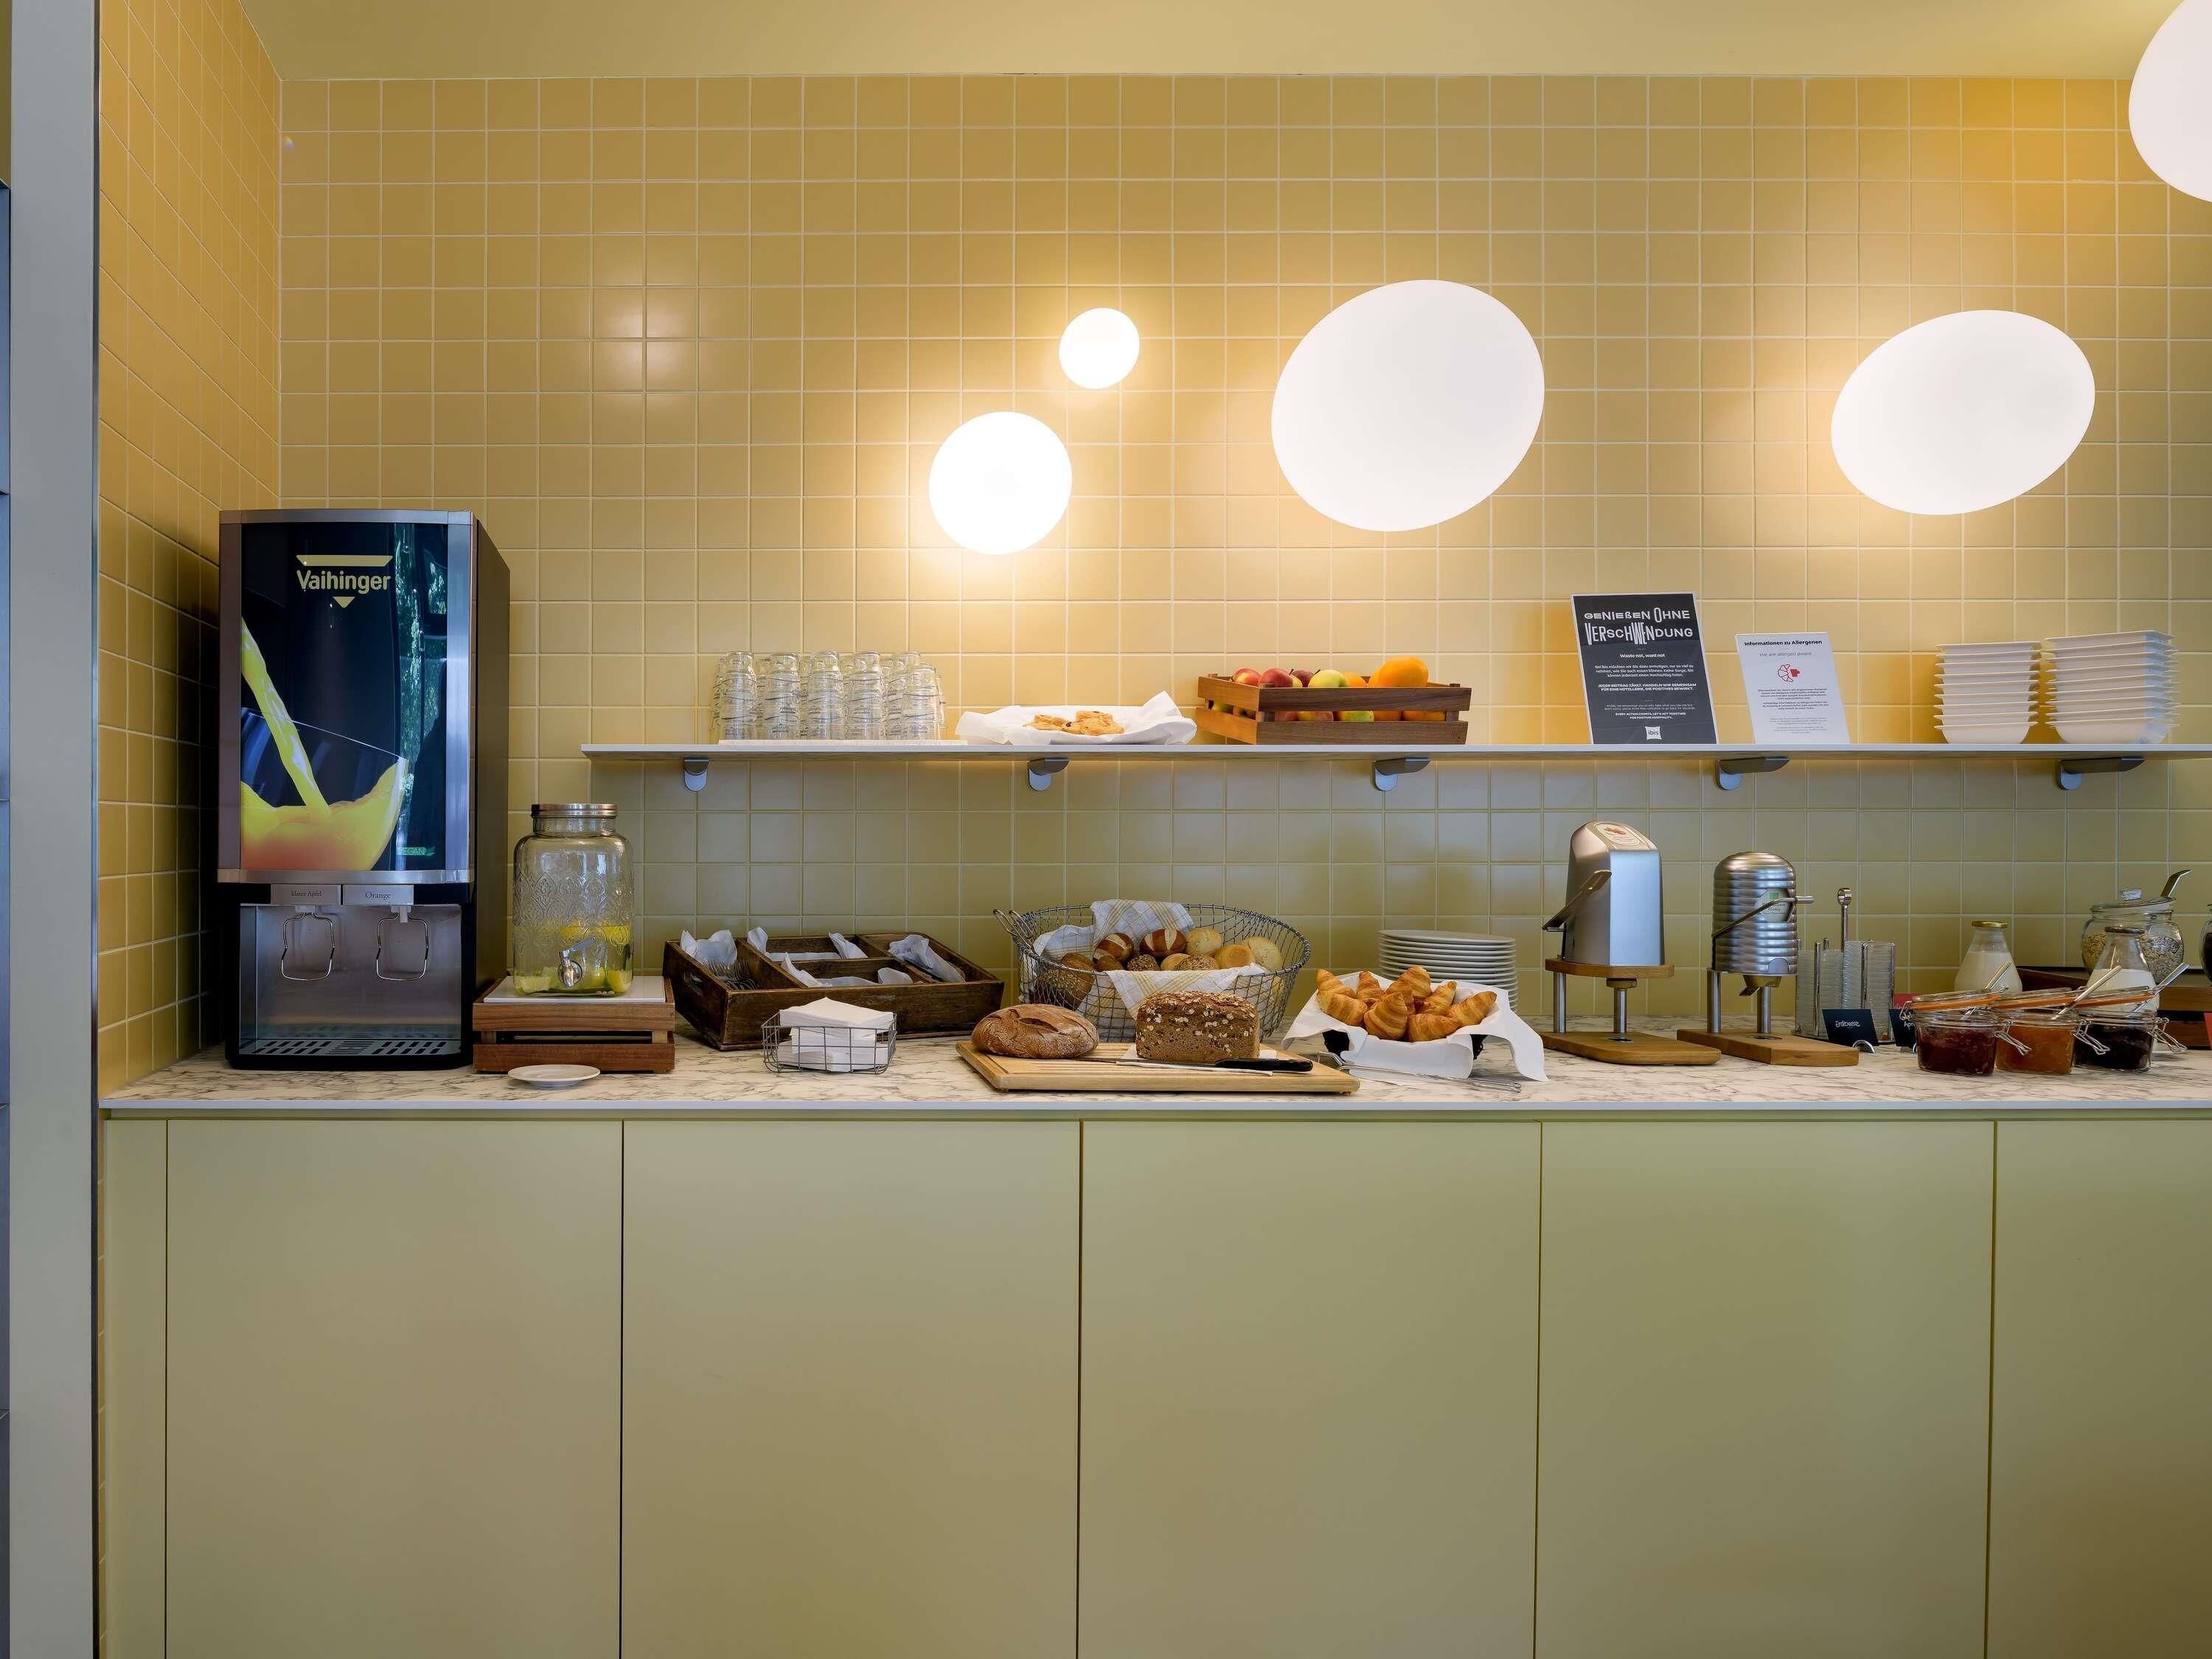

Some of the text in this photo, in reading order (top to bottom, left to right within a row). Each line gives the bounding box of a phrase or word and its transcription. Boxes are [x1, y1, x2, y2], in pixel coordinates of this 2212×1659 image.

[296, 569, 391, 594] Vaihinger
[1654, 607, 1690, 623] OHNE
[365, 891, 391, 901] Orange
